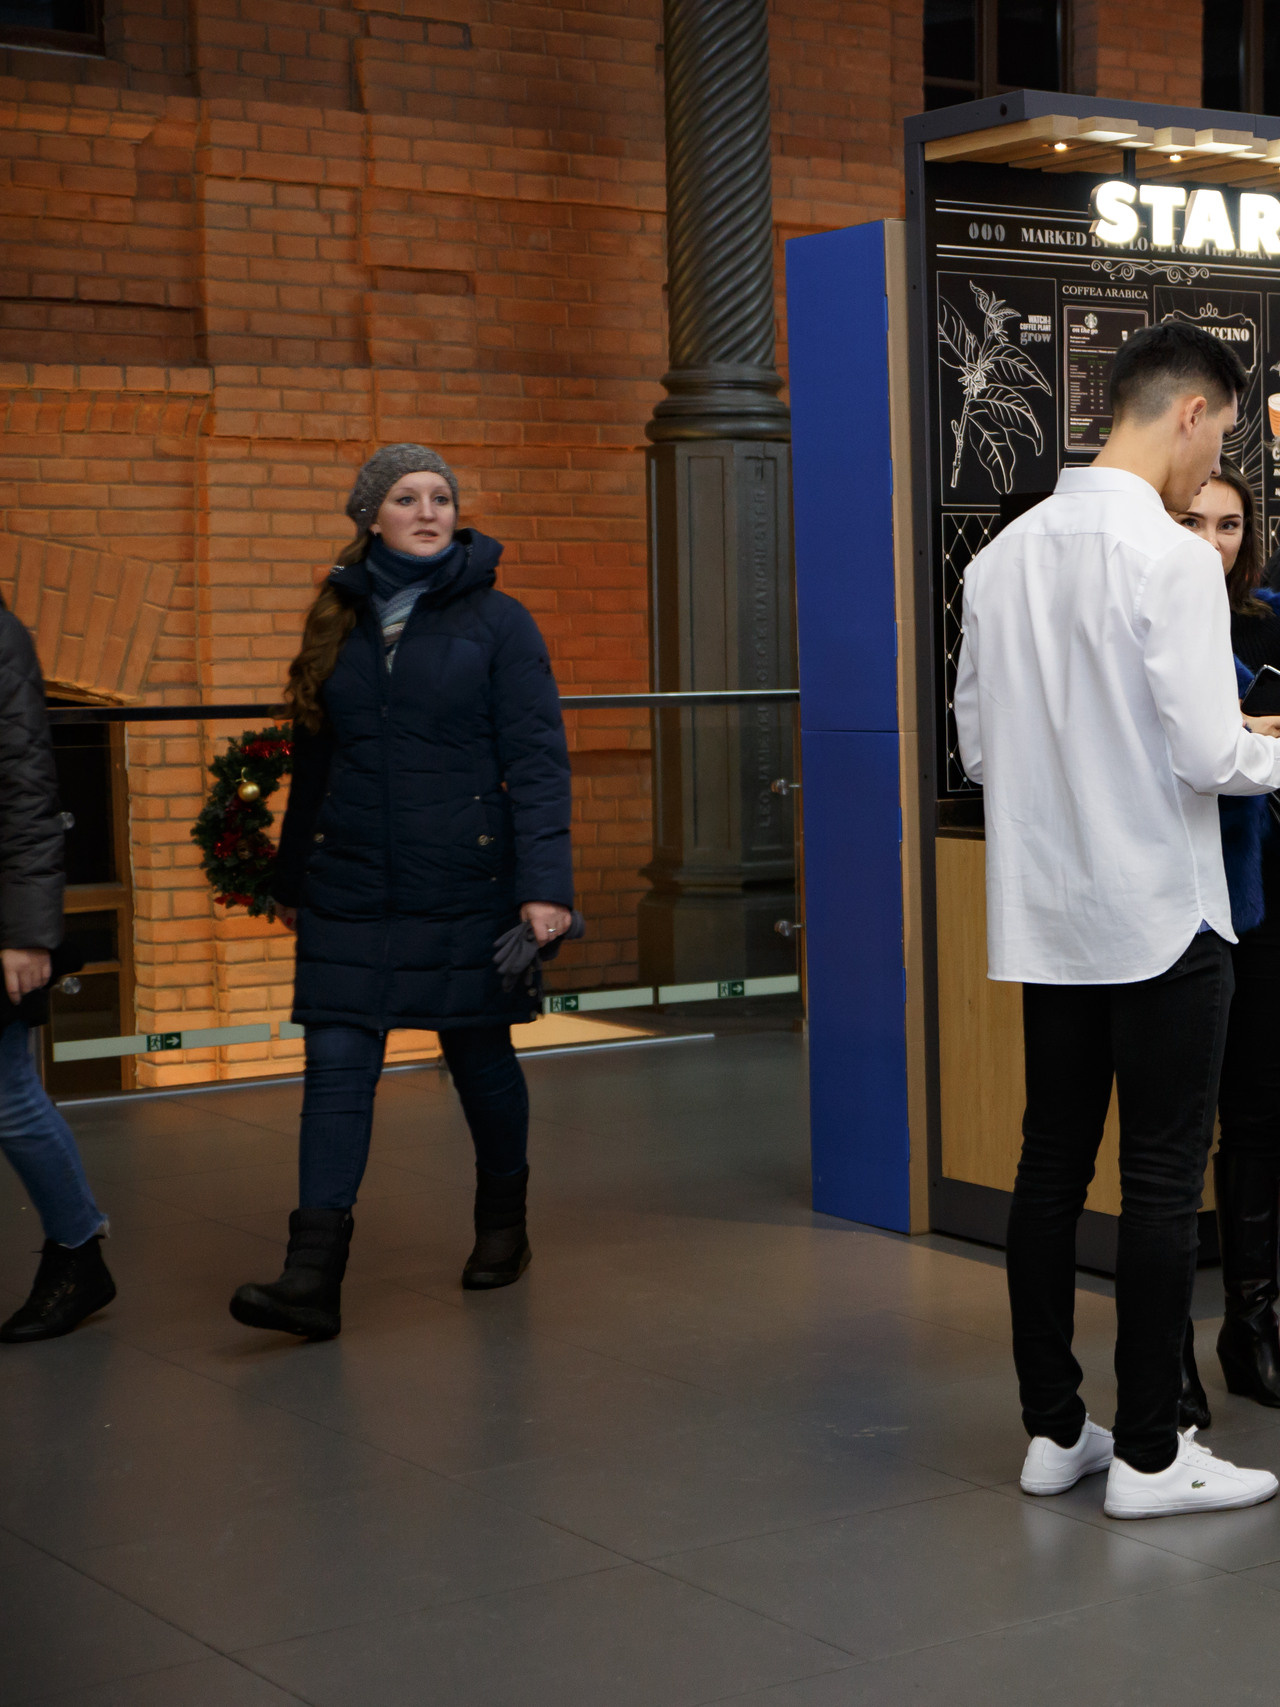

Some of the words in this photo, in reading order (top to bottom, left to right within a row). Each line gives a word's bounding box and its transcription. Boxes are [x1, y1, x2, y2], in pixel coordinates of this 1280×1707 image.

[1021, 227, 1087, 247] MARKED
[1062, 285, 1103, 297] COFFEA
[1105, 288, 1148, 300] ARABICA
[1020, 331, 1052, 346] grow
